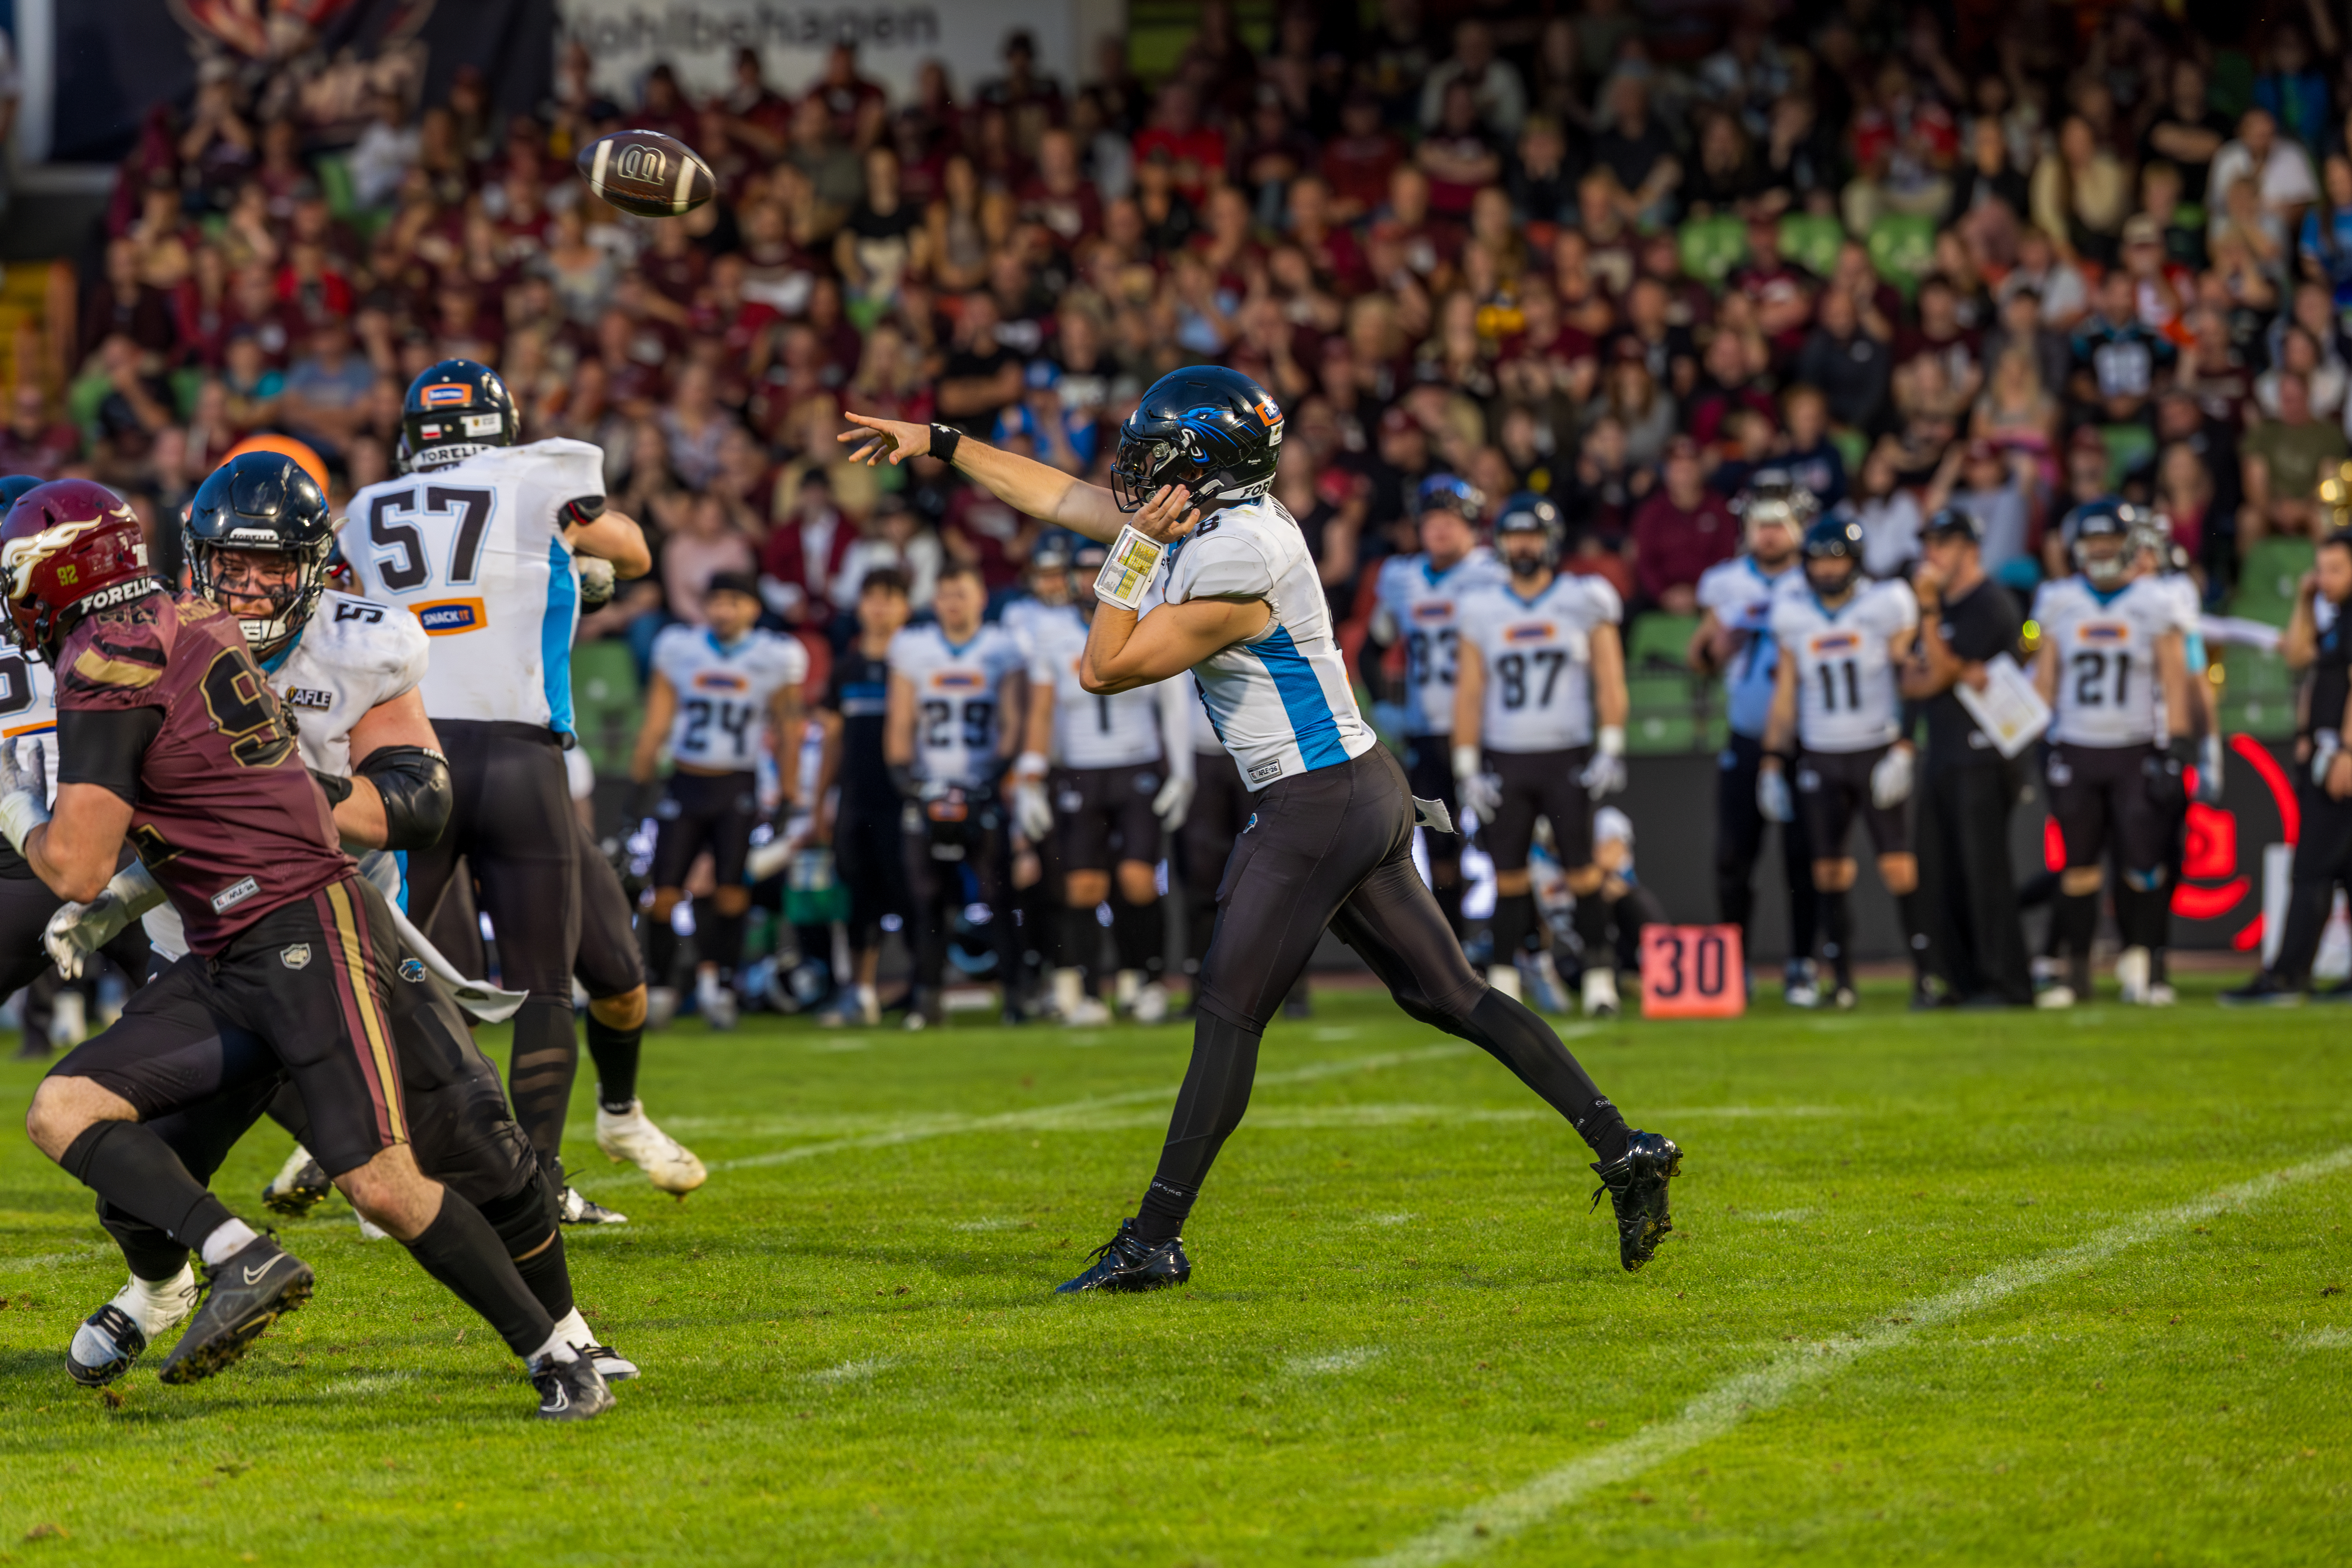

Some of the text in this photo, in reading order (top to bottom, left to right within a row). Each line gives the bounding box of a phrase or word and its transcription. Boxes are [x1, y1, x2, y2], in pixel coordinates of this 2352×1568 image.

[370, 485, 491, 591] 57
[57, 564, 78, 586] 92
[80, 577, 152, 615] FORELL
[290, 690, 331, 707] AFLE
[1497, 651, 1567, 710] 87
[1820, 660, 1859, 713] 11
[2076, 652, 2131, 705] 21
[684, 701, 748, 757] 24
[921, 702, 988, 748] 29
[1653, 937, 1726, 998] 30
